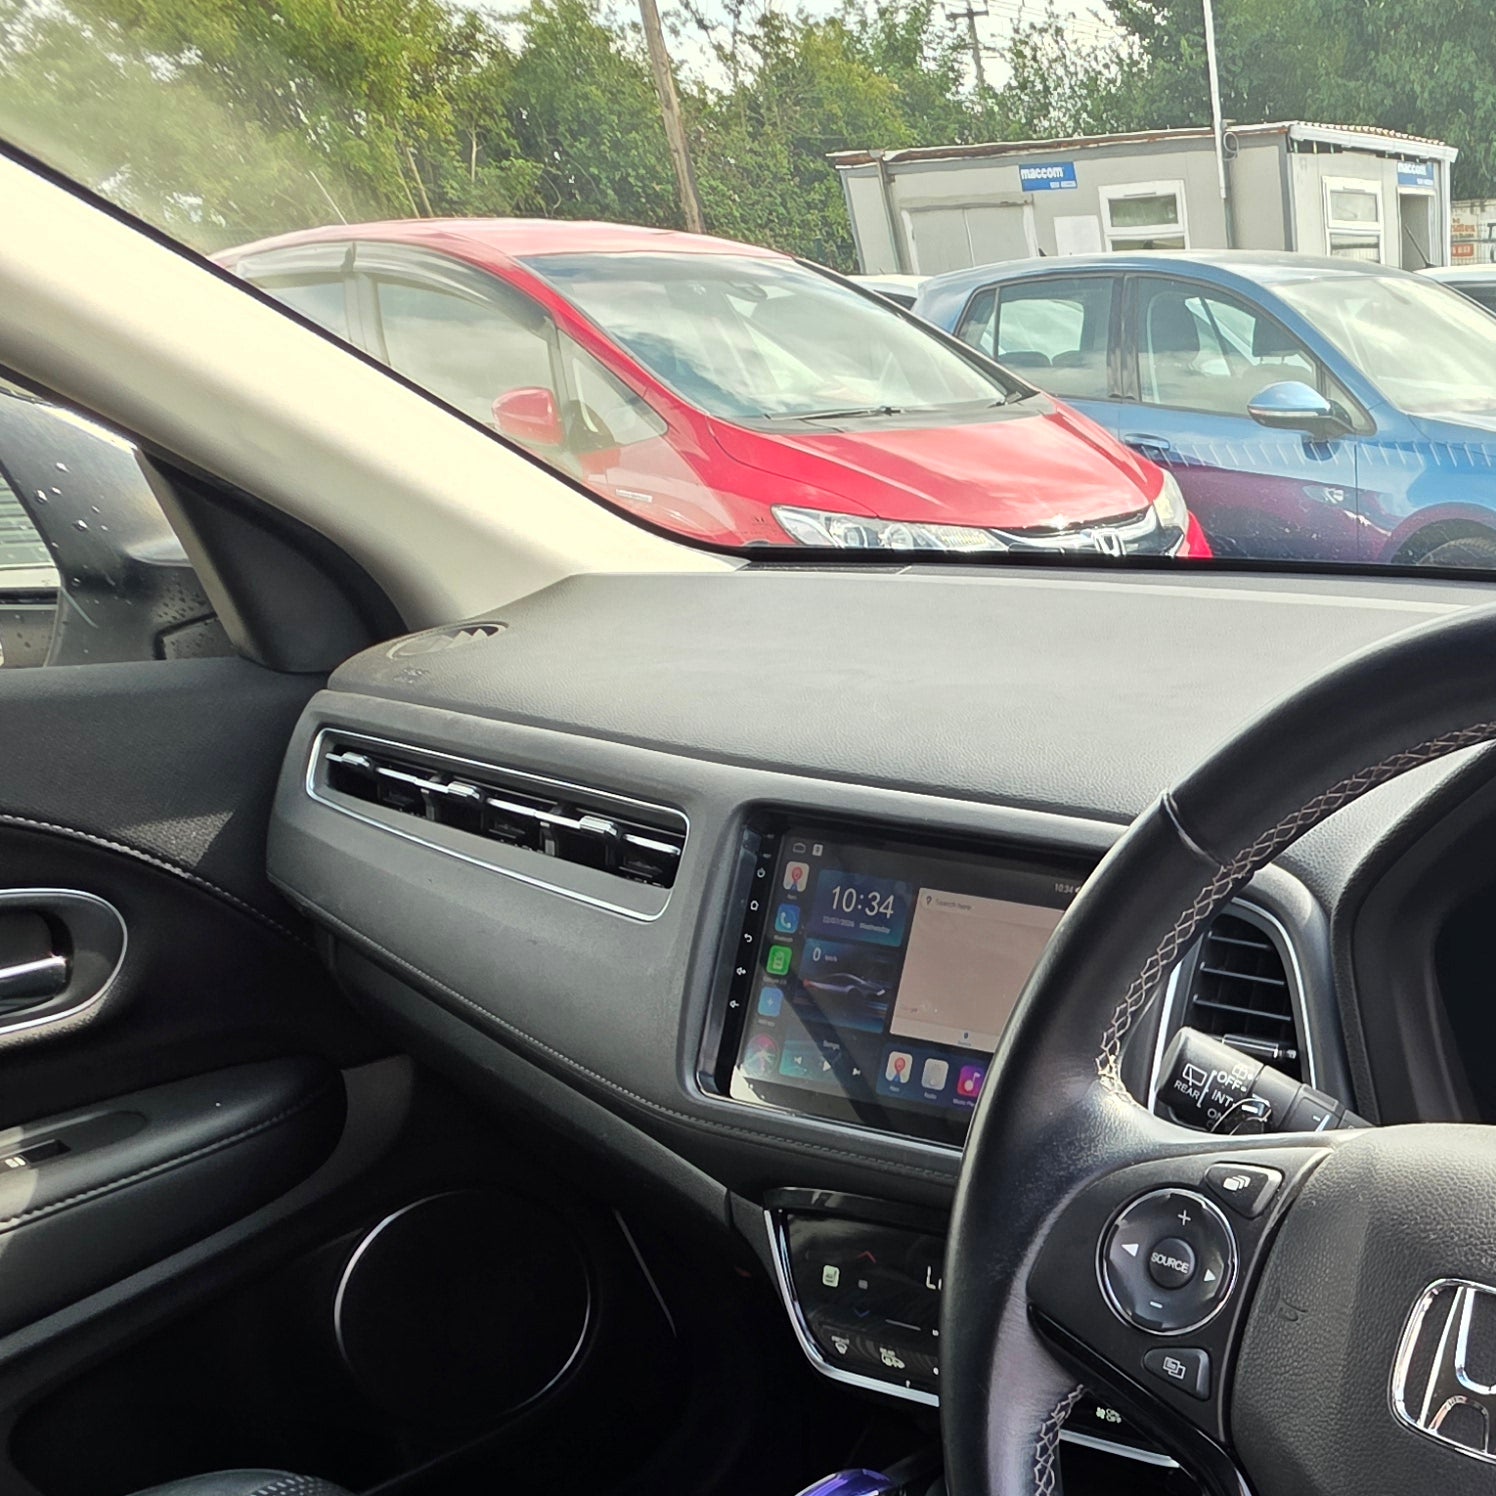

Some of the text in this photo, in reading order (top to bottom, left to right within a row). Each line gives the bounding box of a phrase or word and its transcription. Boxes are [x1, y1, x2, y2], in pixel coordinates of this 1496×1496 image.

[831, 886, 895, 919] 10:34
[1173, 1079, 1200, 1100] REAR
[1216, 1072, 1242, 1091] OFF
[1211, 1089, 1234, 1108] INT
[1150, 1251, 1190, 1274] SOURCE
